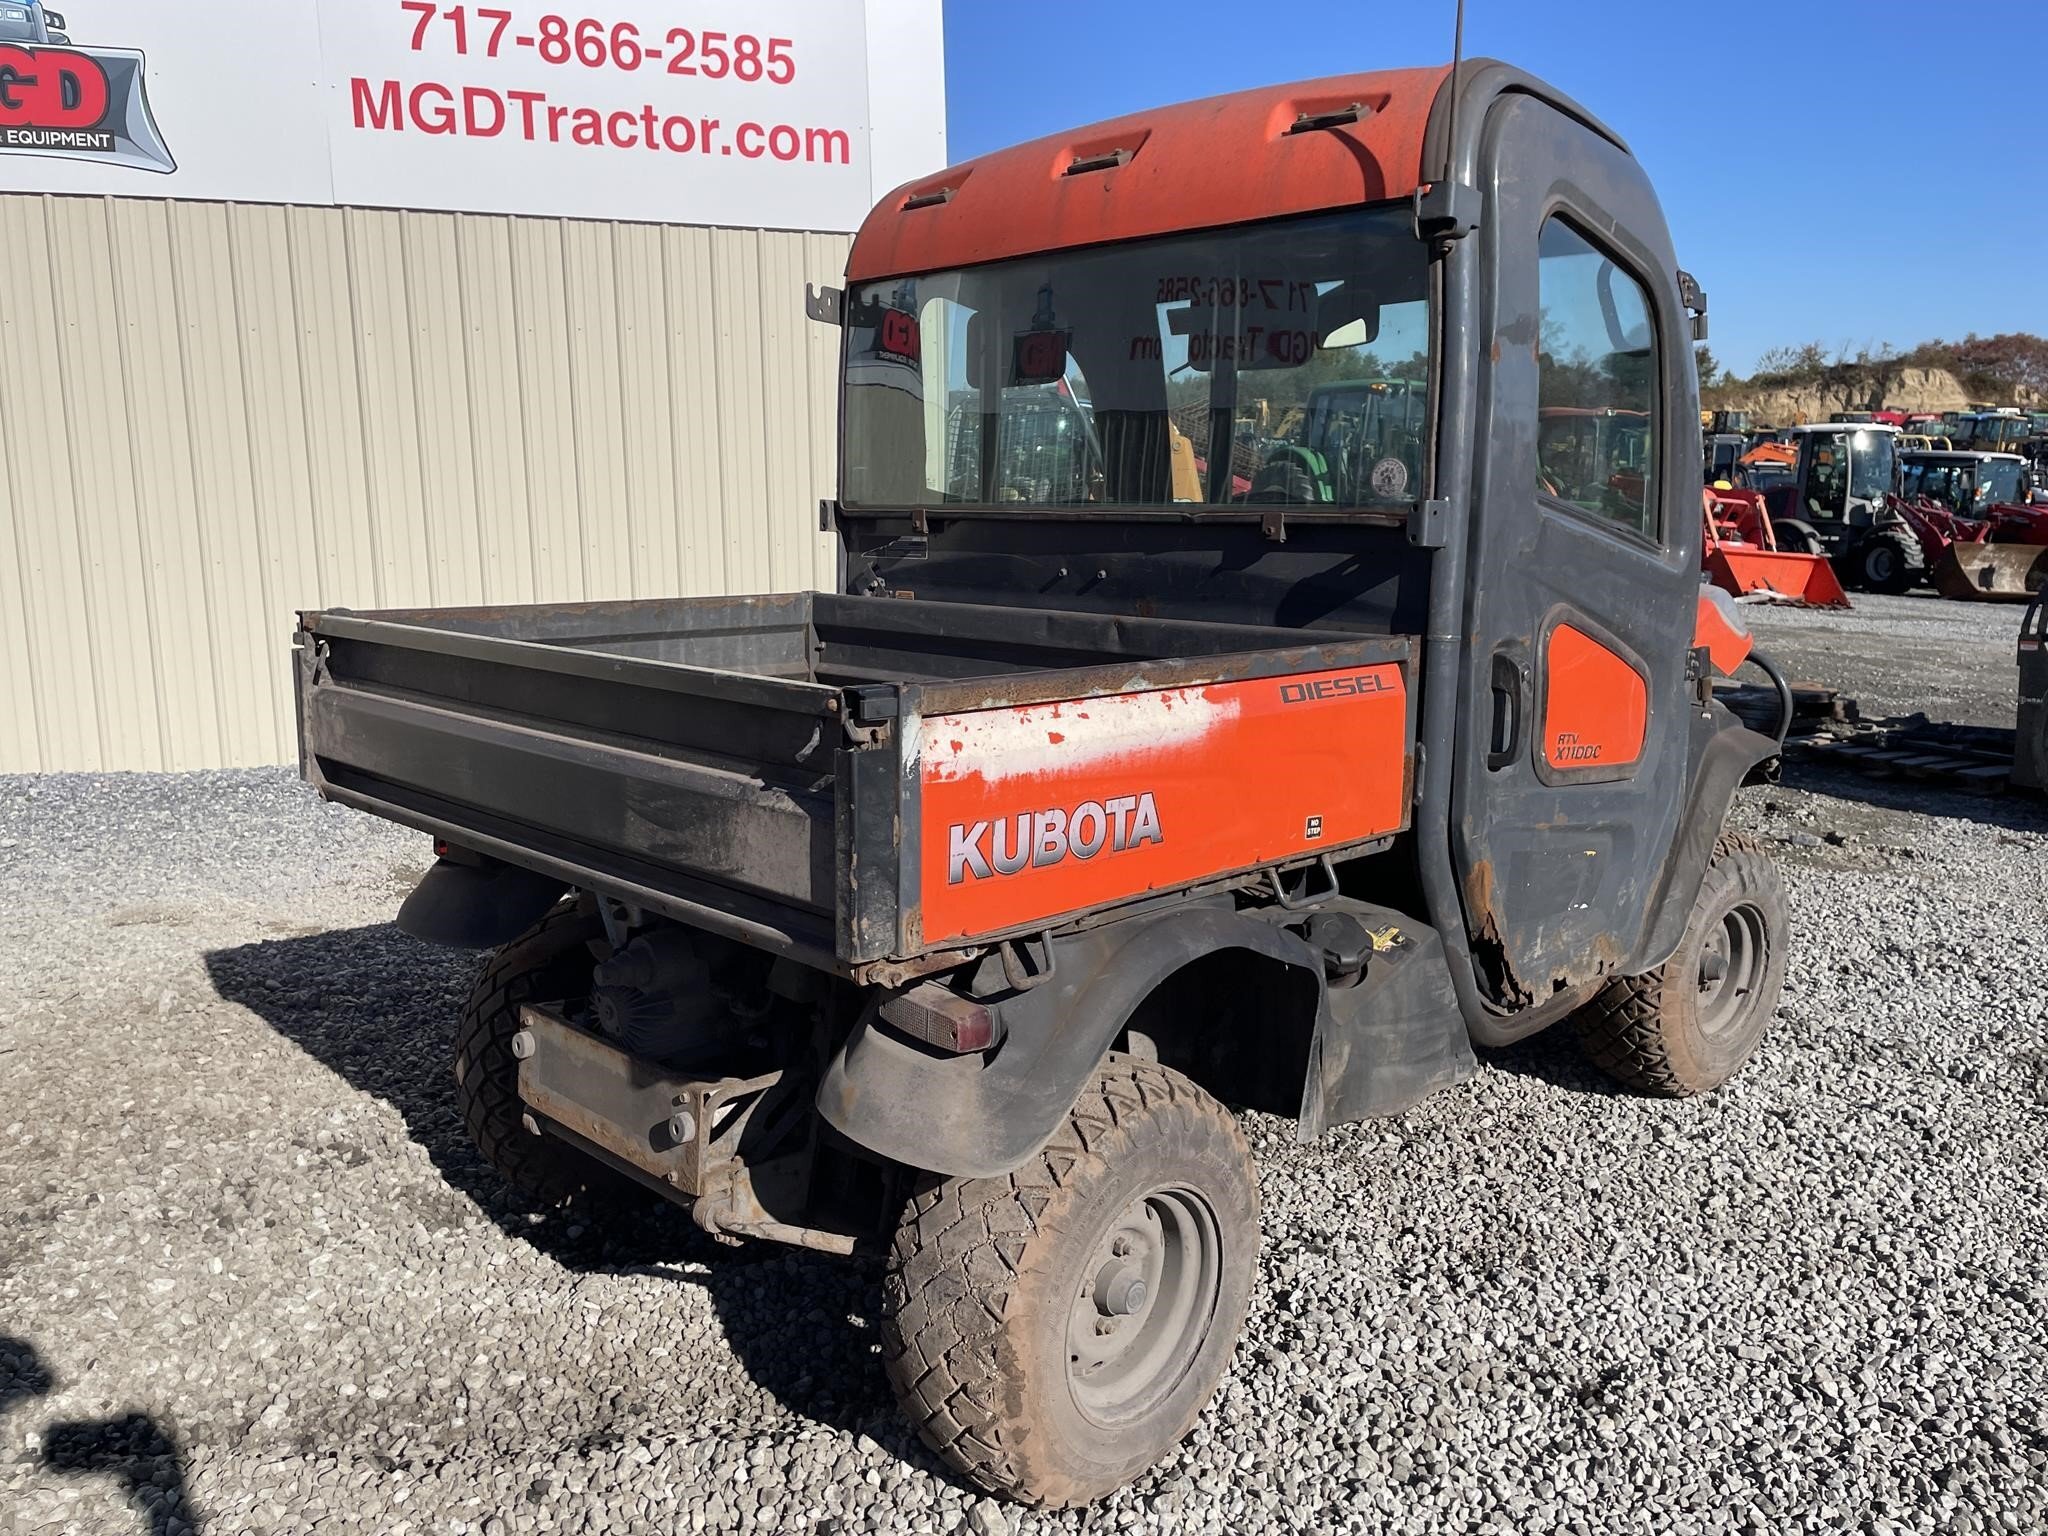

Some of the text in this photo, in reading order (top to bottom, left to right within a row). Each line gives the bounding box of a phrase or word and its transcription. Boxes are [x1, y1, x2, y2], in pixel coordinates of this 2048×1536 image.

[401, 1, 796, 85] 717-866-2585
[351, 77, 850, 165] MGDTractor.com
[7, 129, 110, 148] EQUIPMENT
[1280, 674, 1395, 704] DIESEL
[1557, 733, 1580, 745] RTV
[1310, 818, 1320, 827] NO
[948, 792, 1163, 885] KUBOTA
